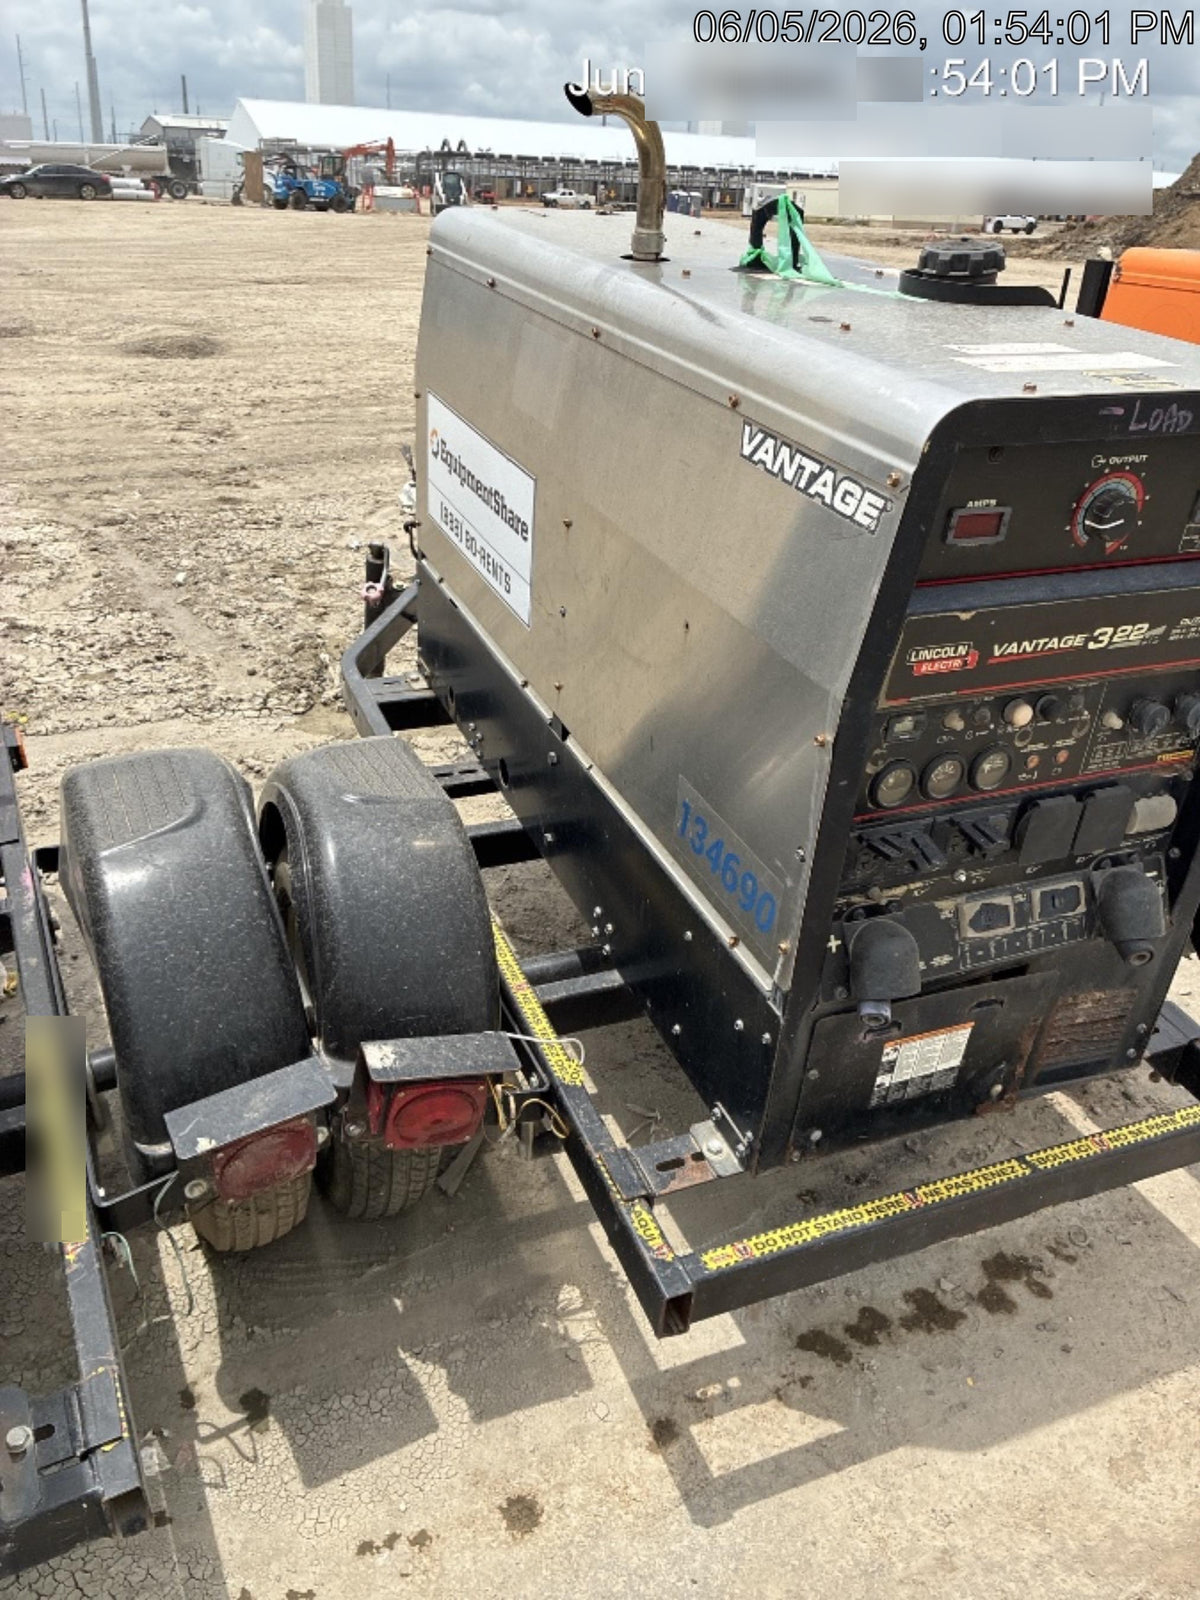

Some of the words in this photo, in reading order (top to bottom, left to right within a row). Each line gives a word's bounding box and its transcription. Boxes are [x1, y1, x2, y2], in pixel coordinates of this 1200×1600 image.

[1129, 400, 1194, 433] LOAD
[740, 419, 886, 534] VANTAGE
[1108, 454, 1149, 465] OUTPUT
[440, 437, 530, 543] EquipmentShare
[910, 643, 969, 663] LINCOLN
[993, 633, 1089, 657] VANTAGE
[1088, 623, 1151, 650] 322
[920, 658, 965, 675] ELECTR
[677, 798, 778, 934] 134690
[922, 1188, 945, 1201] NE
[943, 1178, 973, 1195] PAS
[971, 1164, 1018, 1185] TENEZ
[1074, 1143, 1092, 1156] ICI
[753, 1235, 778, 1252] DO
[780, 1225, 813, 1243] NOT
[813, 1210, 864, 1234] STAND
[865, 1198, 905, 1217] HERE
